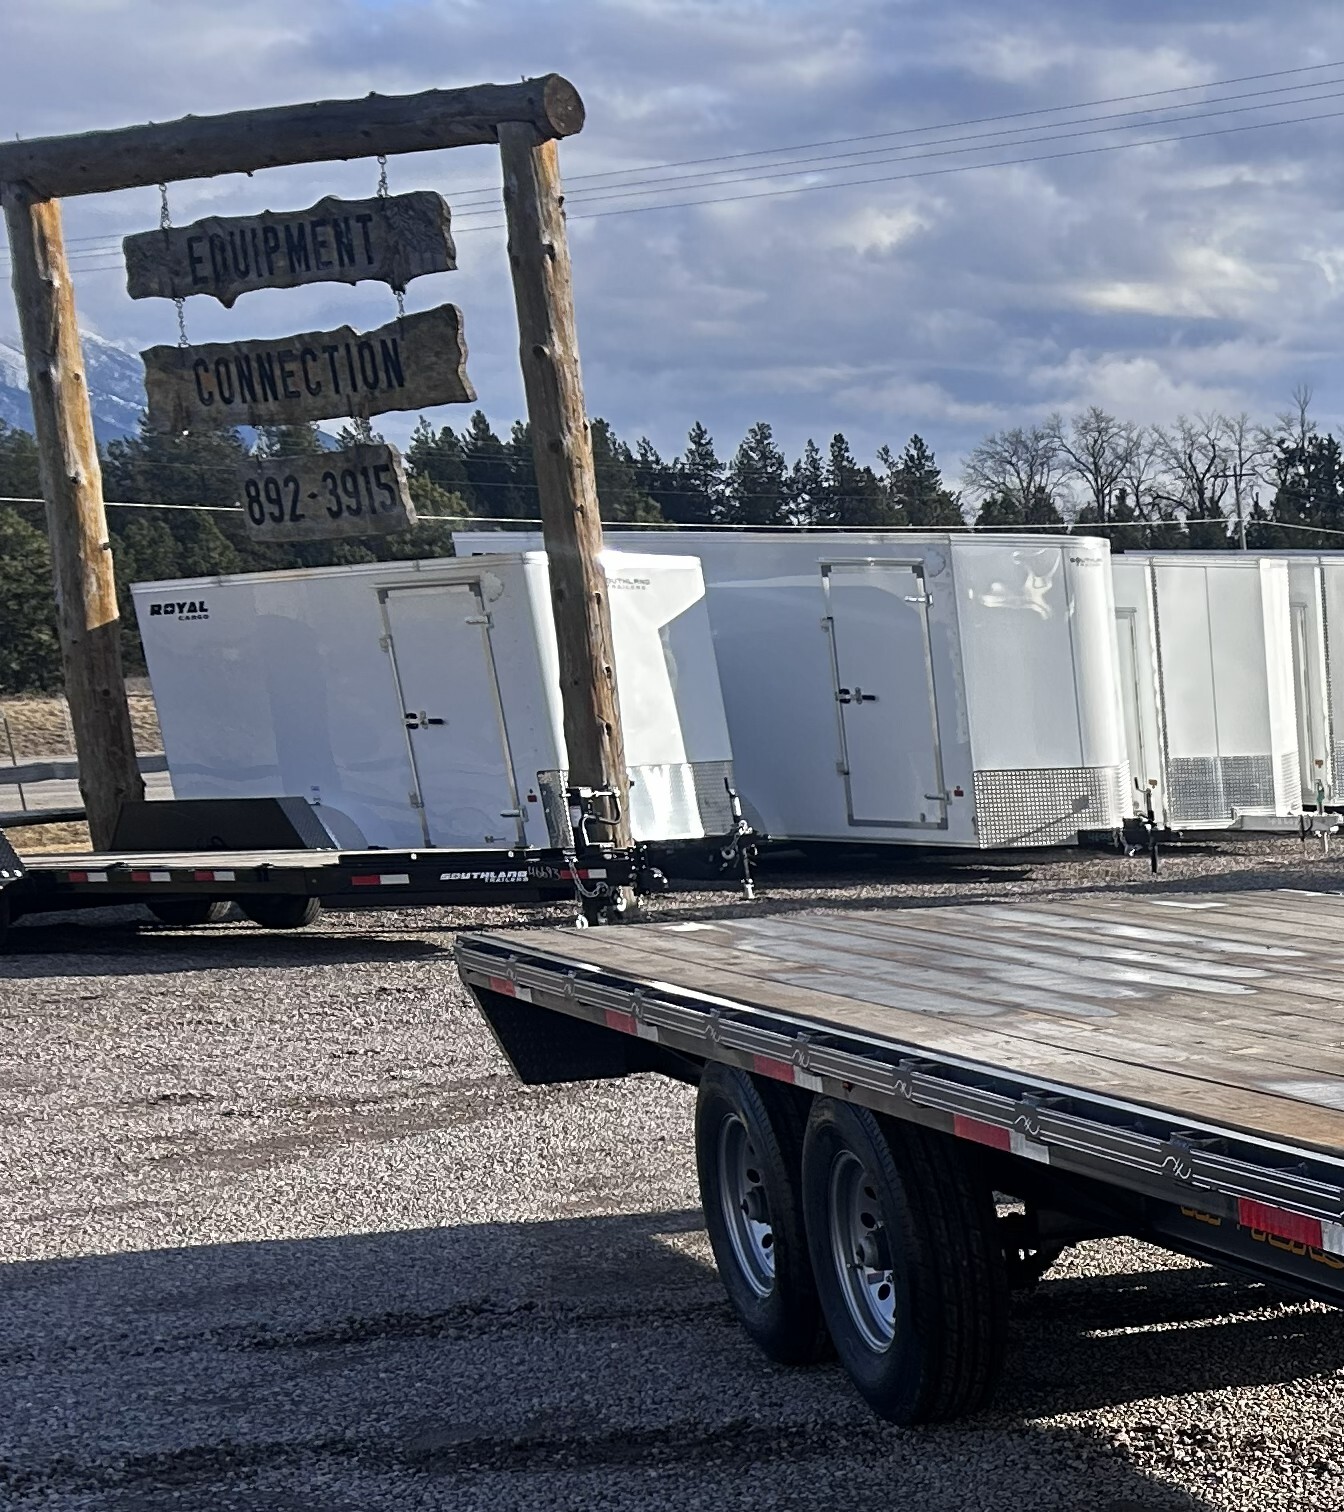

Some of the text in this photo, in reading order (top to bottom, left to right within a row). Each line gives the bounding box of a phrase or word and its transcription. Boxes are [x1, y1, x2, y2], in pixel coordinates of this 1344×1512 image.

[187, 213, 375, 286] EQUIPMENT
[193, 338, 406, 407] CONNECTION
[244, 463, 397, 528] 892-3915
[150, 600, 209, 616] ROYAL
[440, 870, 528, 881] SOUTHLAND
